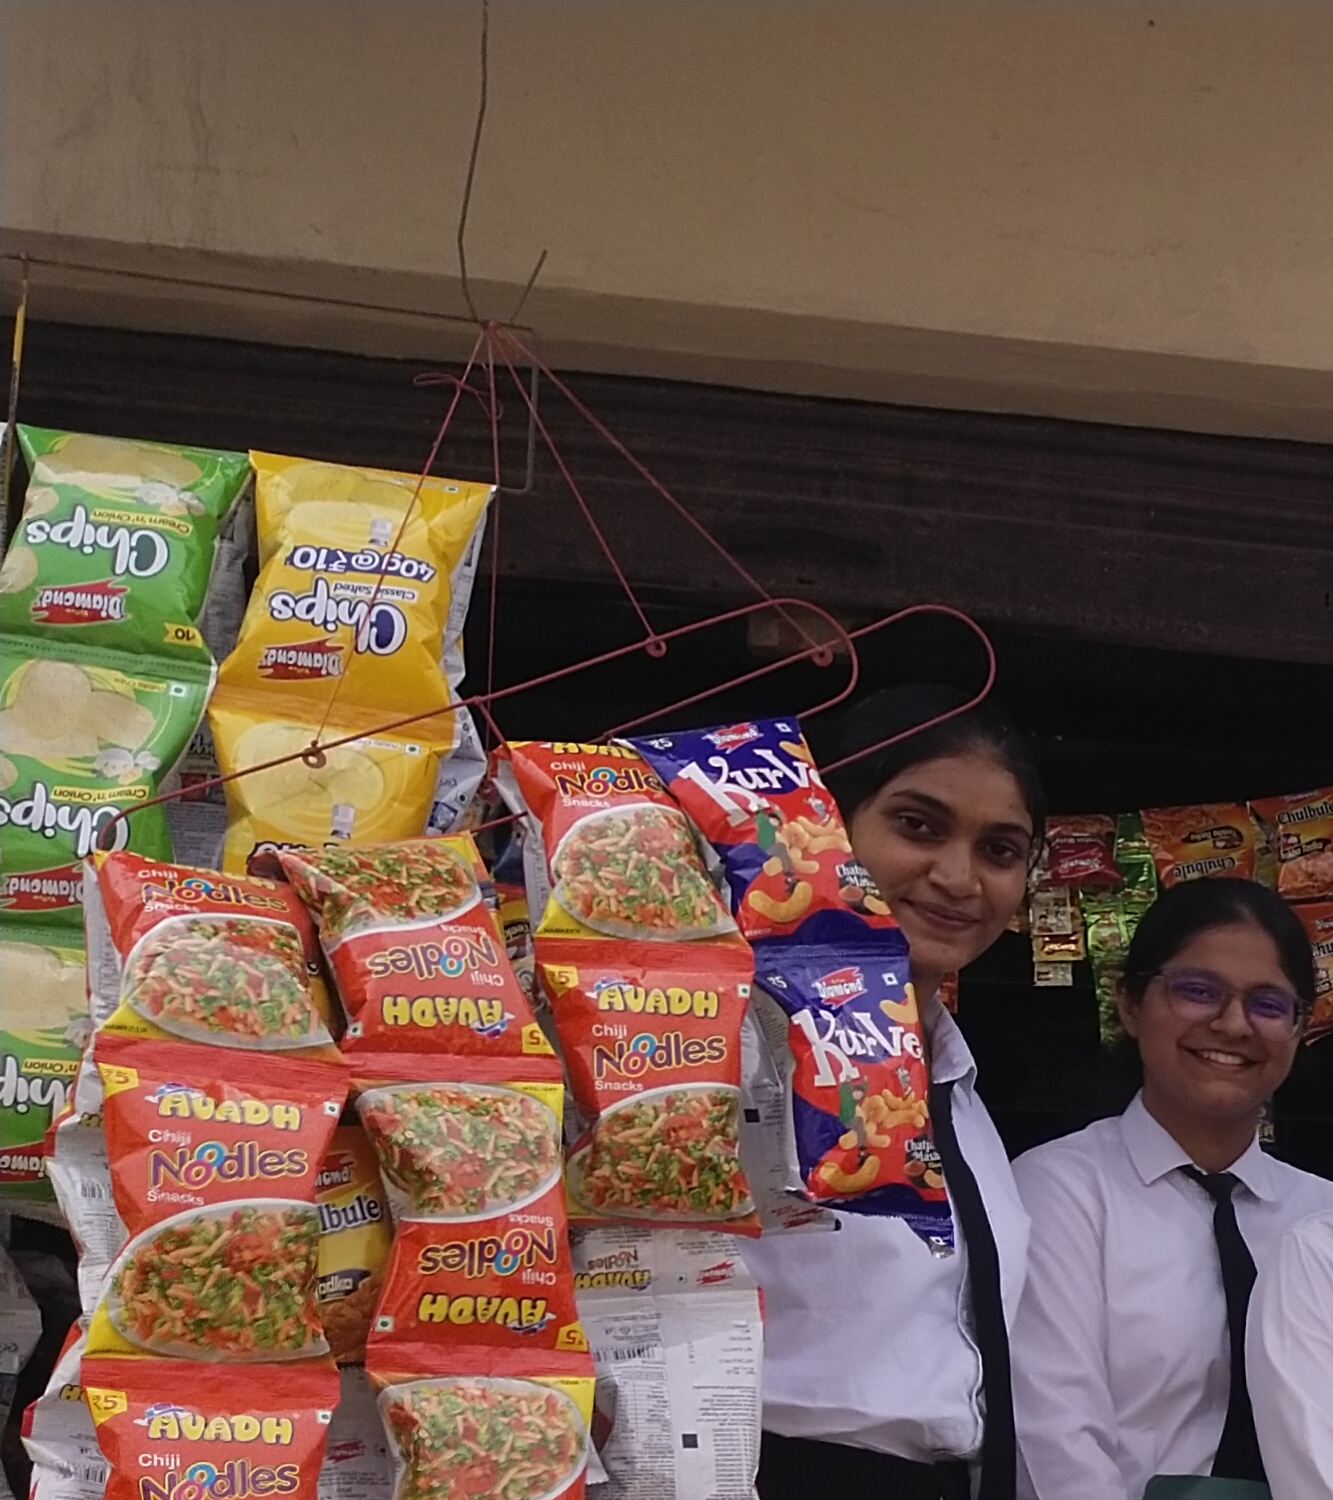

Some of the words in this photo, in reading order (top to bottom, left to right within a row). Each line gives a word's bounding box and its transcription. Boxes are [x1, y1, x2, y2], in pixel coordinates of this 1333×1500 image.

[26, 504, 169, 577] Chips
[270, 577, 407, 655] Chips
[549, 760, 588, 775] Chiji
[554, 766, 663, 798] Noodle
[53, 788, 92, 802] Onion
[138, 868, 179, 880] Chiji
[1173, 855, 1237, 879] Chulbule
[142, 877, 291, 914] Noodles
[440, 922, 487, 937] Snacks
[367, 936, 499, 981] Noodles
[470, 972, 505, 987] Chiji
[381, 996, 503, 1028] AVADH
[598, 987, 719, 1018] AVADH
[591, 1024, 628, 1039] Chiji
[593, 1031, 727, 1079] Noodles
[594, 1080, 644, 1092] Snacks
[158, 1091, 302, 1132] AVADH
[148, 1128, 192, 1147] Chiji
[148, 1140, 309, 1190] Noodles
[147, 1189, 206, 1206] Snacks
[317, 1194, 382, 1235] lbule
[509, 1213, 554, 1227] Snacks
[419, 1228, 558, 1279] Noodles
[318, 1276, 354, 1296] adka
[521, 1271, 557, 1286] Chiji
[574, 1268, 651, 1291] AVADH
[417, 1293, 547, 1326] AVADH
[147, 1414, 294, 1446] AVADH
[138, 1453, 182, 1470] Chiji
